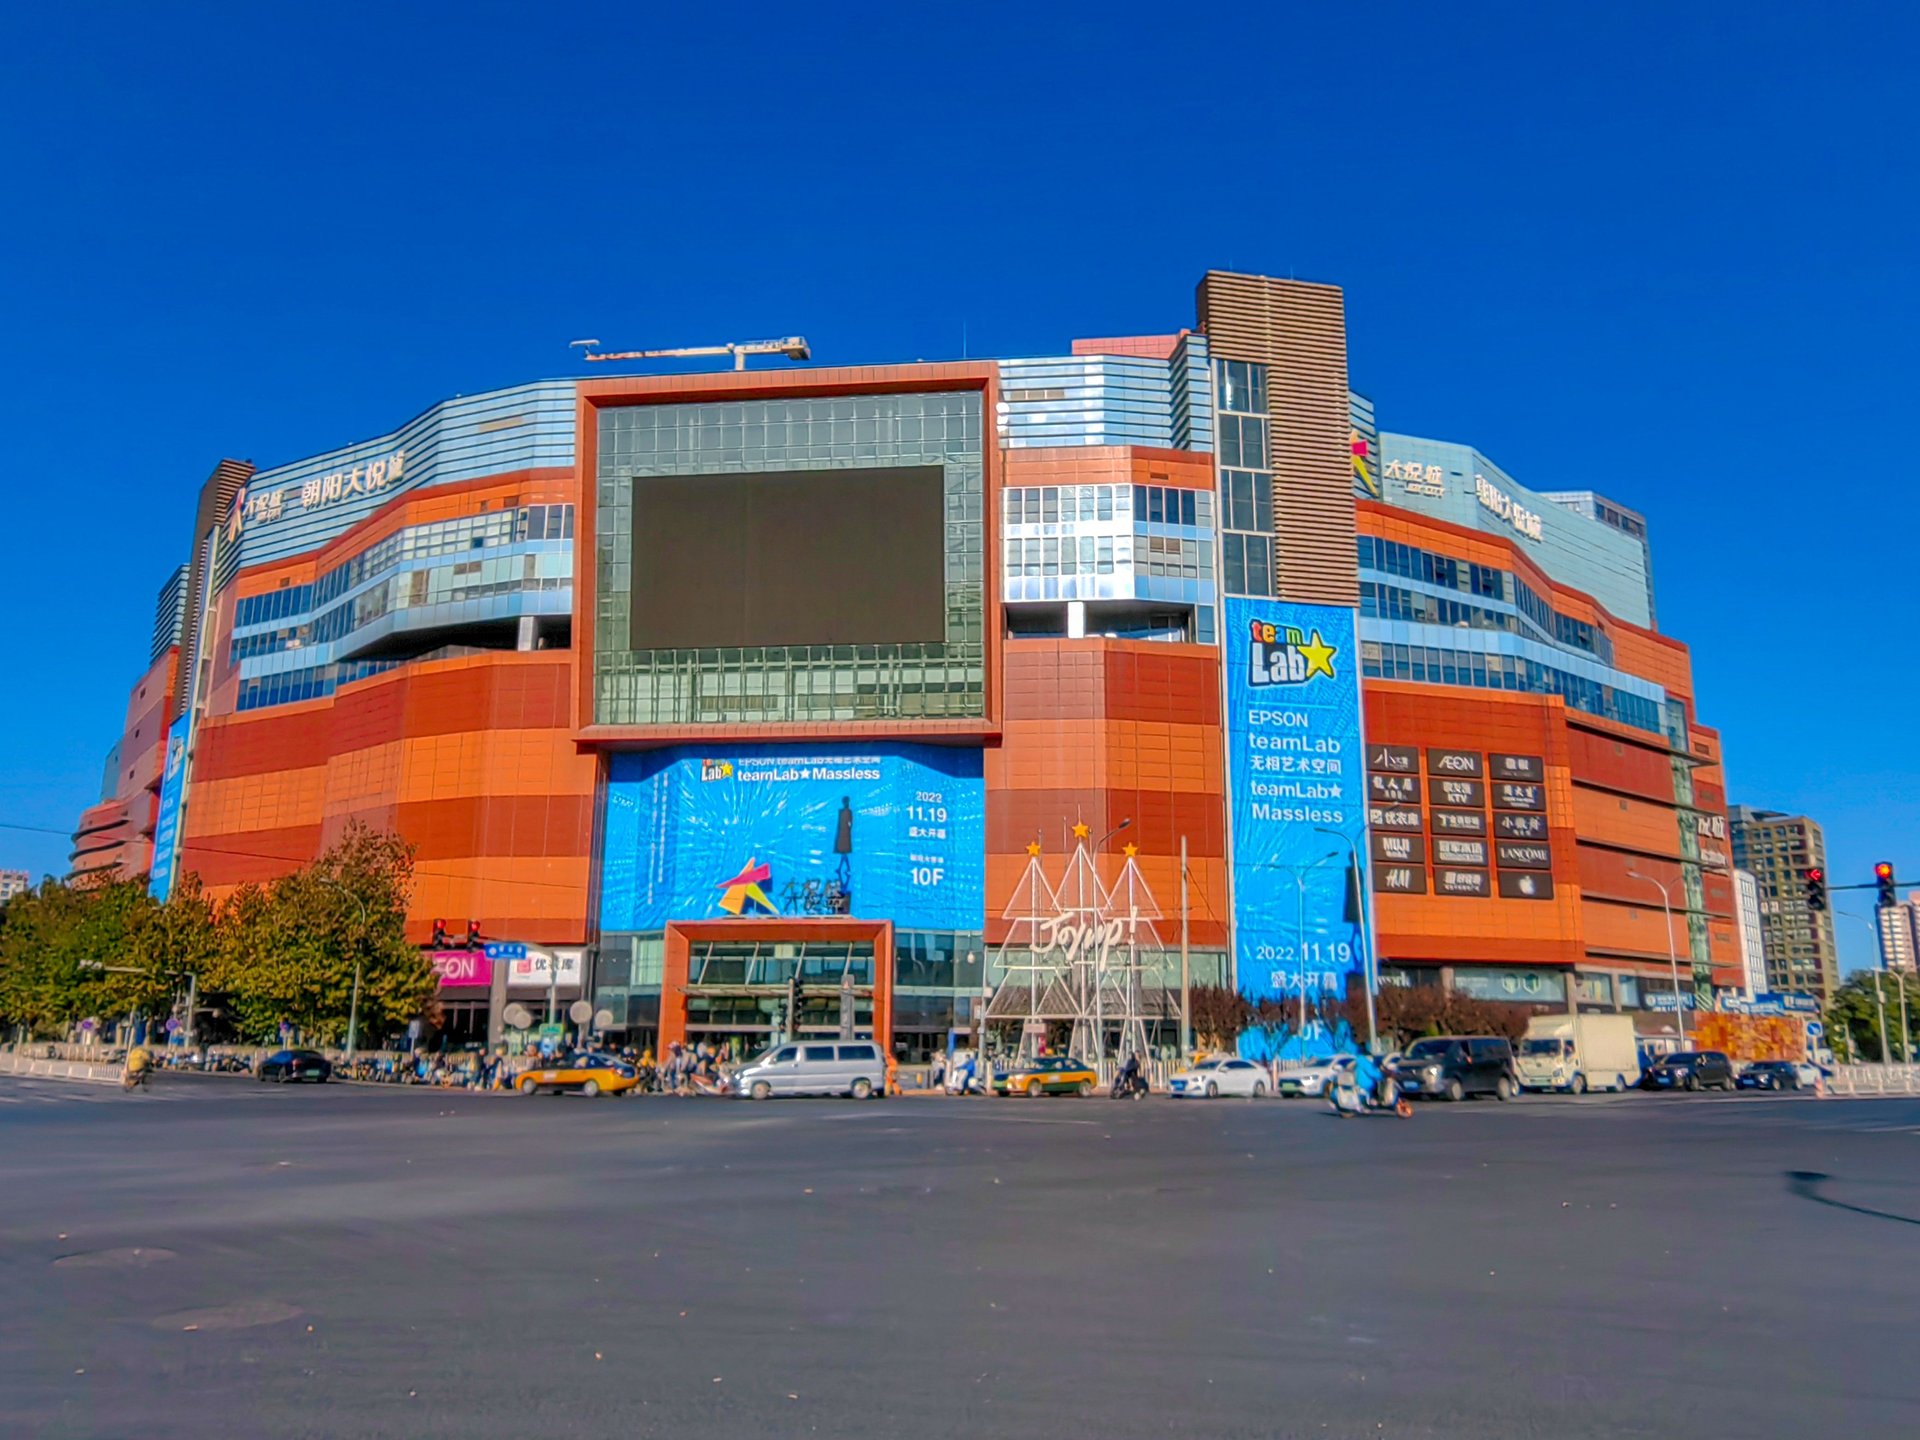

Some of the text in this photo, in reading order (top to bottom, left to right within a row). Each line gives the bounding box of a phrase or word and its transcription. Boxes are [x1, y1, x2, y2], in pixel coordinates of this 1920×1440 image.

[302, 452, 406, 508] 朝阳大悦城
[1250, 619, 1303, 645] team
[1251, 641, 1307, 684] Lab
[1248, 709, 1309, 728] EPSON
[1248, 732, 1341, 754] teamLab
[812, 767, 880, 780] Massless
[1250, 755, 1342, 775] 无相艺术空间
[916, 791, 942, 803] 2022
[906, 805, 947, 822] 11.19
[1251, 802, 1344, 824] Massless
[1382, 837, 1410, 852] MUJI
[911, 867, 944, 886] 10F
[534, 957, 574, 971] 优库
